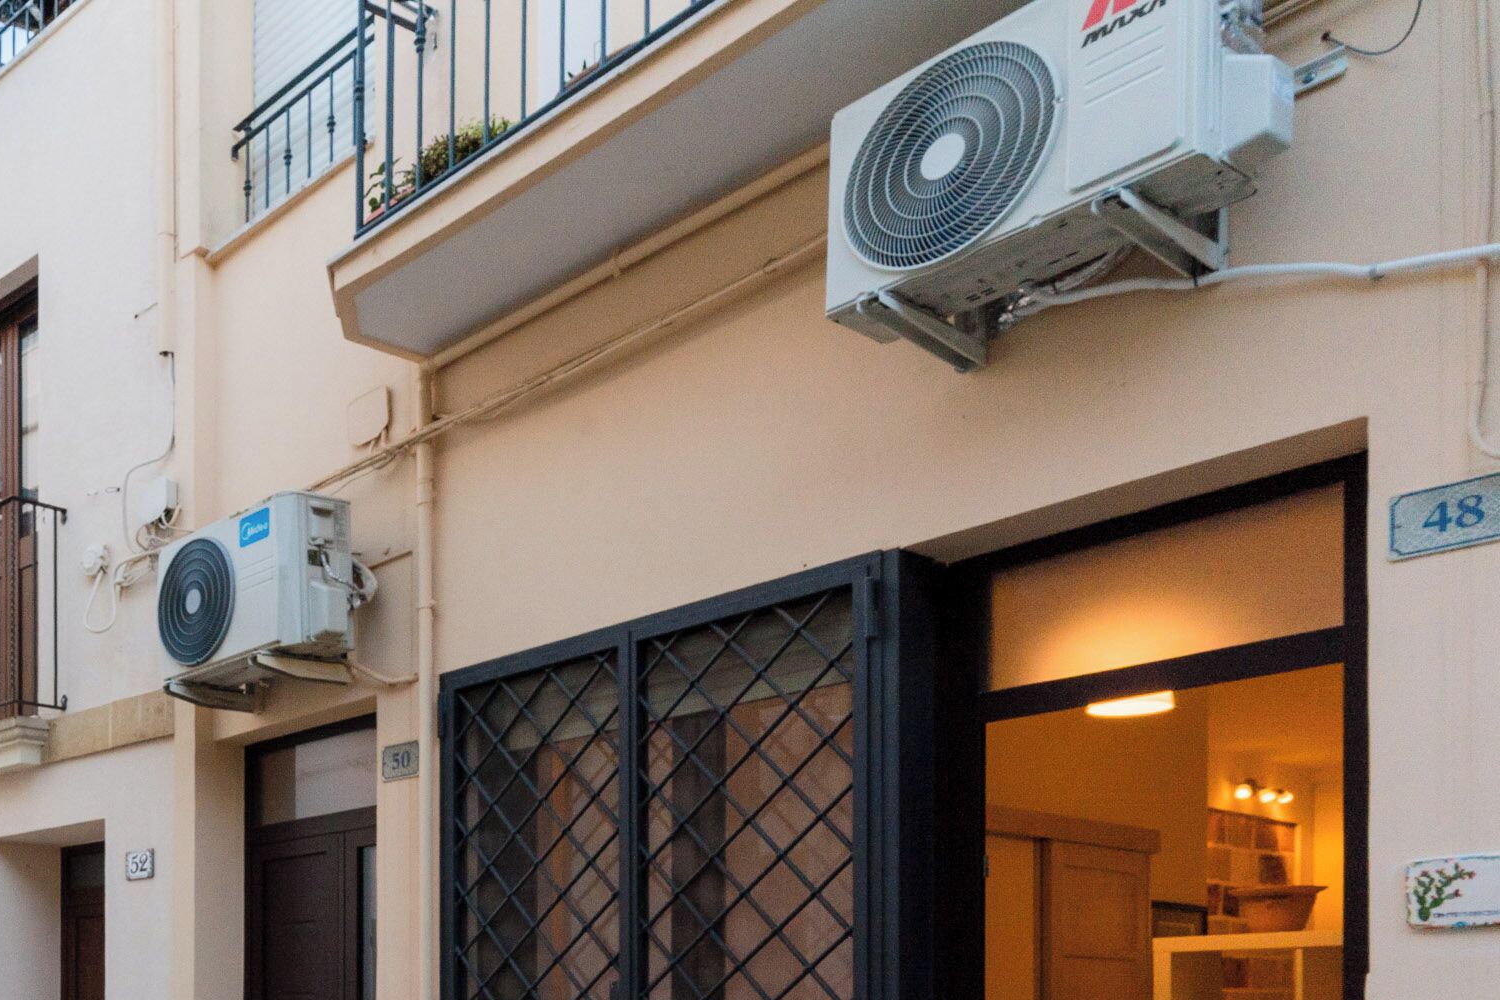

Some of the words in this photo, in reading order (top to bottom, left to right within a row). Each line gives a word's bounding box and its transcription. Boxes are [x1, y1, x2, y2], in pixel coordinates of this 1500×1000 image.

[1421, 494, 1485, 532] 48
[391, 750, 411, 770] 50
[130, 852, 148, 874] 52
